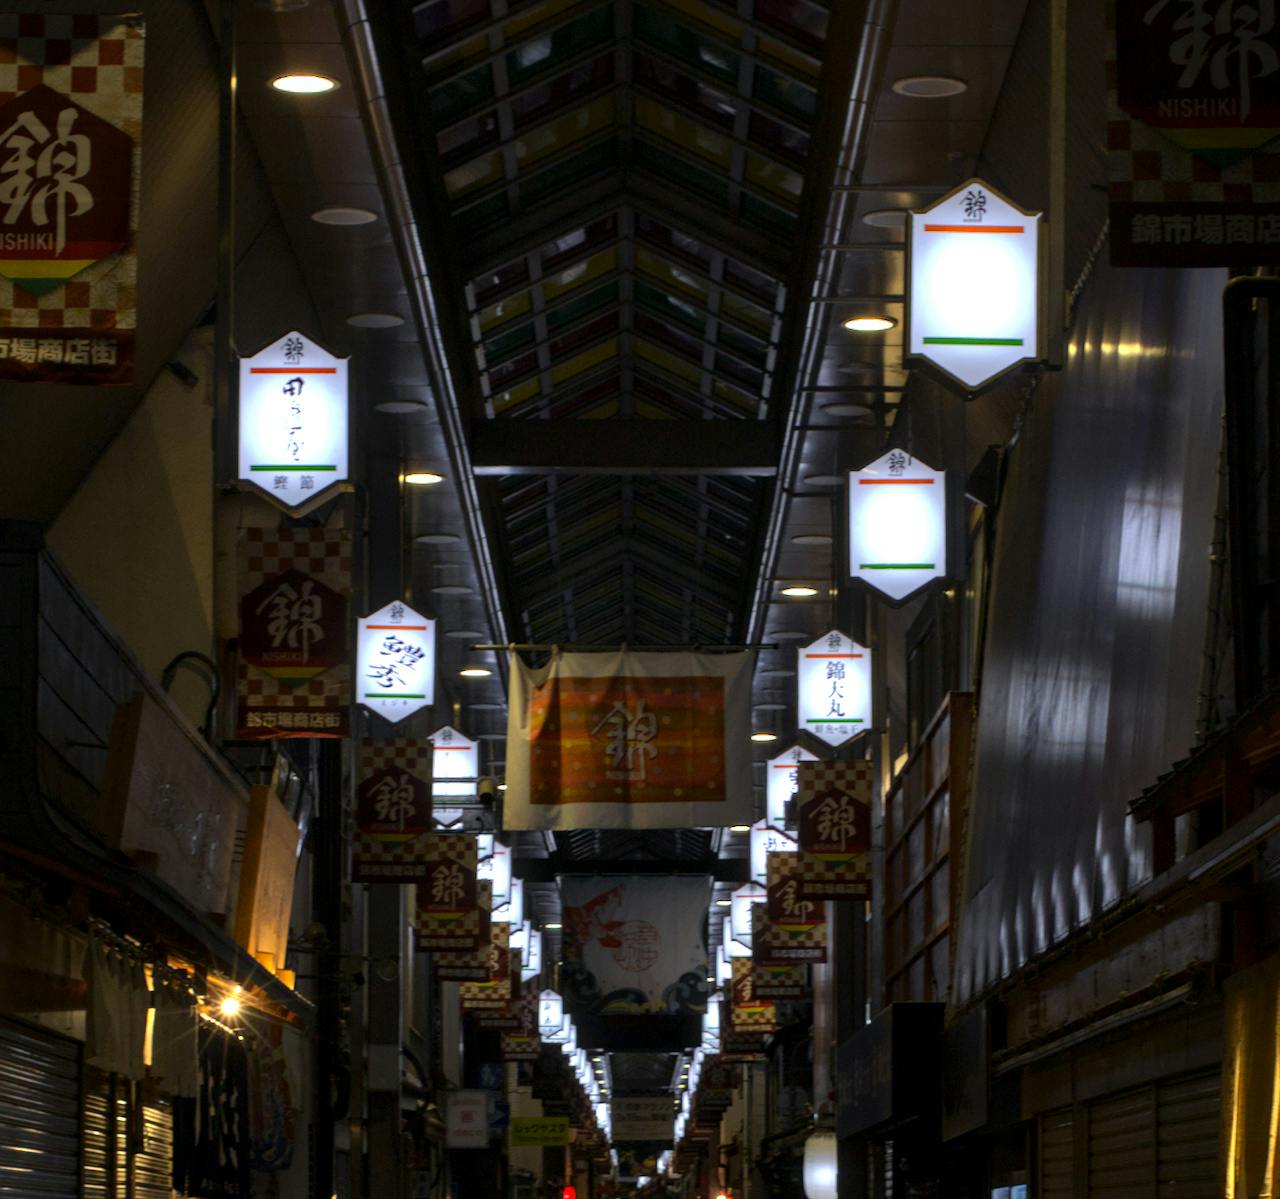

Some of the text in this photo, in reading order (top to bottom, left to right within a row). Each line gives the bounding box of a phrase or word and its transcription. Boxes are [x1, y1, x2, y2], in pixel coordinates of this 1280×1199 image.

[1142, 0, 1280, 124] 錦
[1157, 98, 1238, 118] NISHIKI
[256, 580, 326, 665] 錦
[825, 661, 846, 717] 錦大丸
[246, 711, 342, 729] 錦市場商店街
[591, 698, 658, 781] 錦
[366, 774, 417, 832] 錦
[808, 796, 856, 852] 錦
[431, 864, 466, 911] 錦
